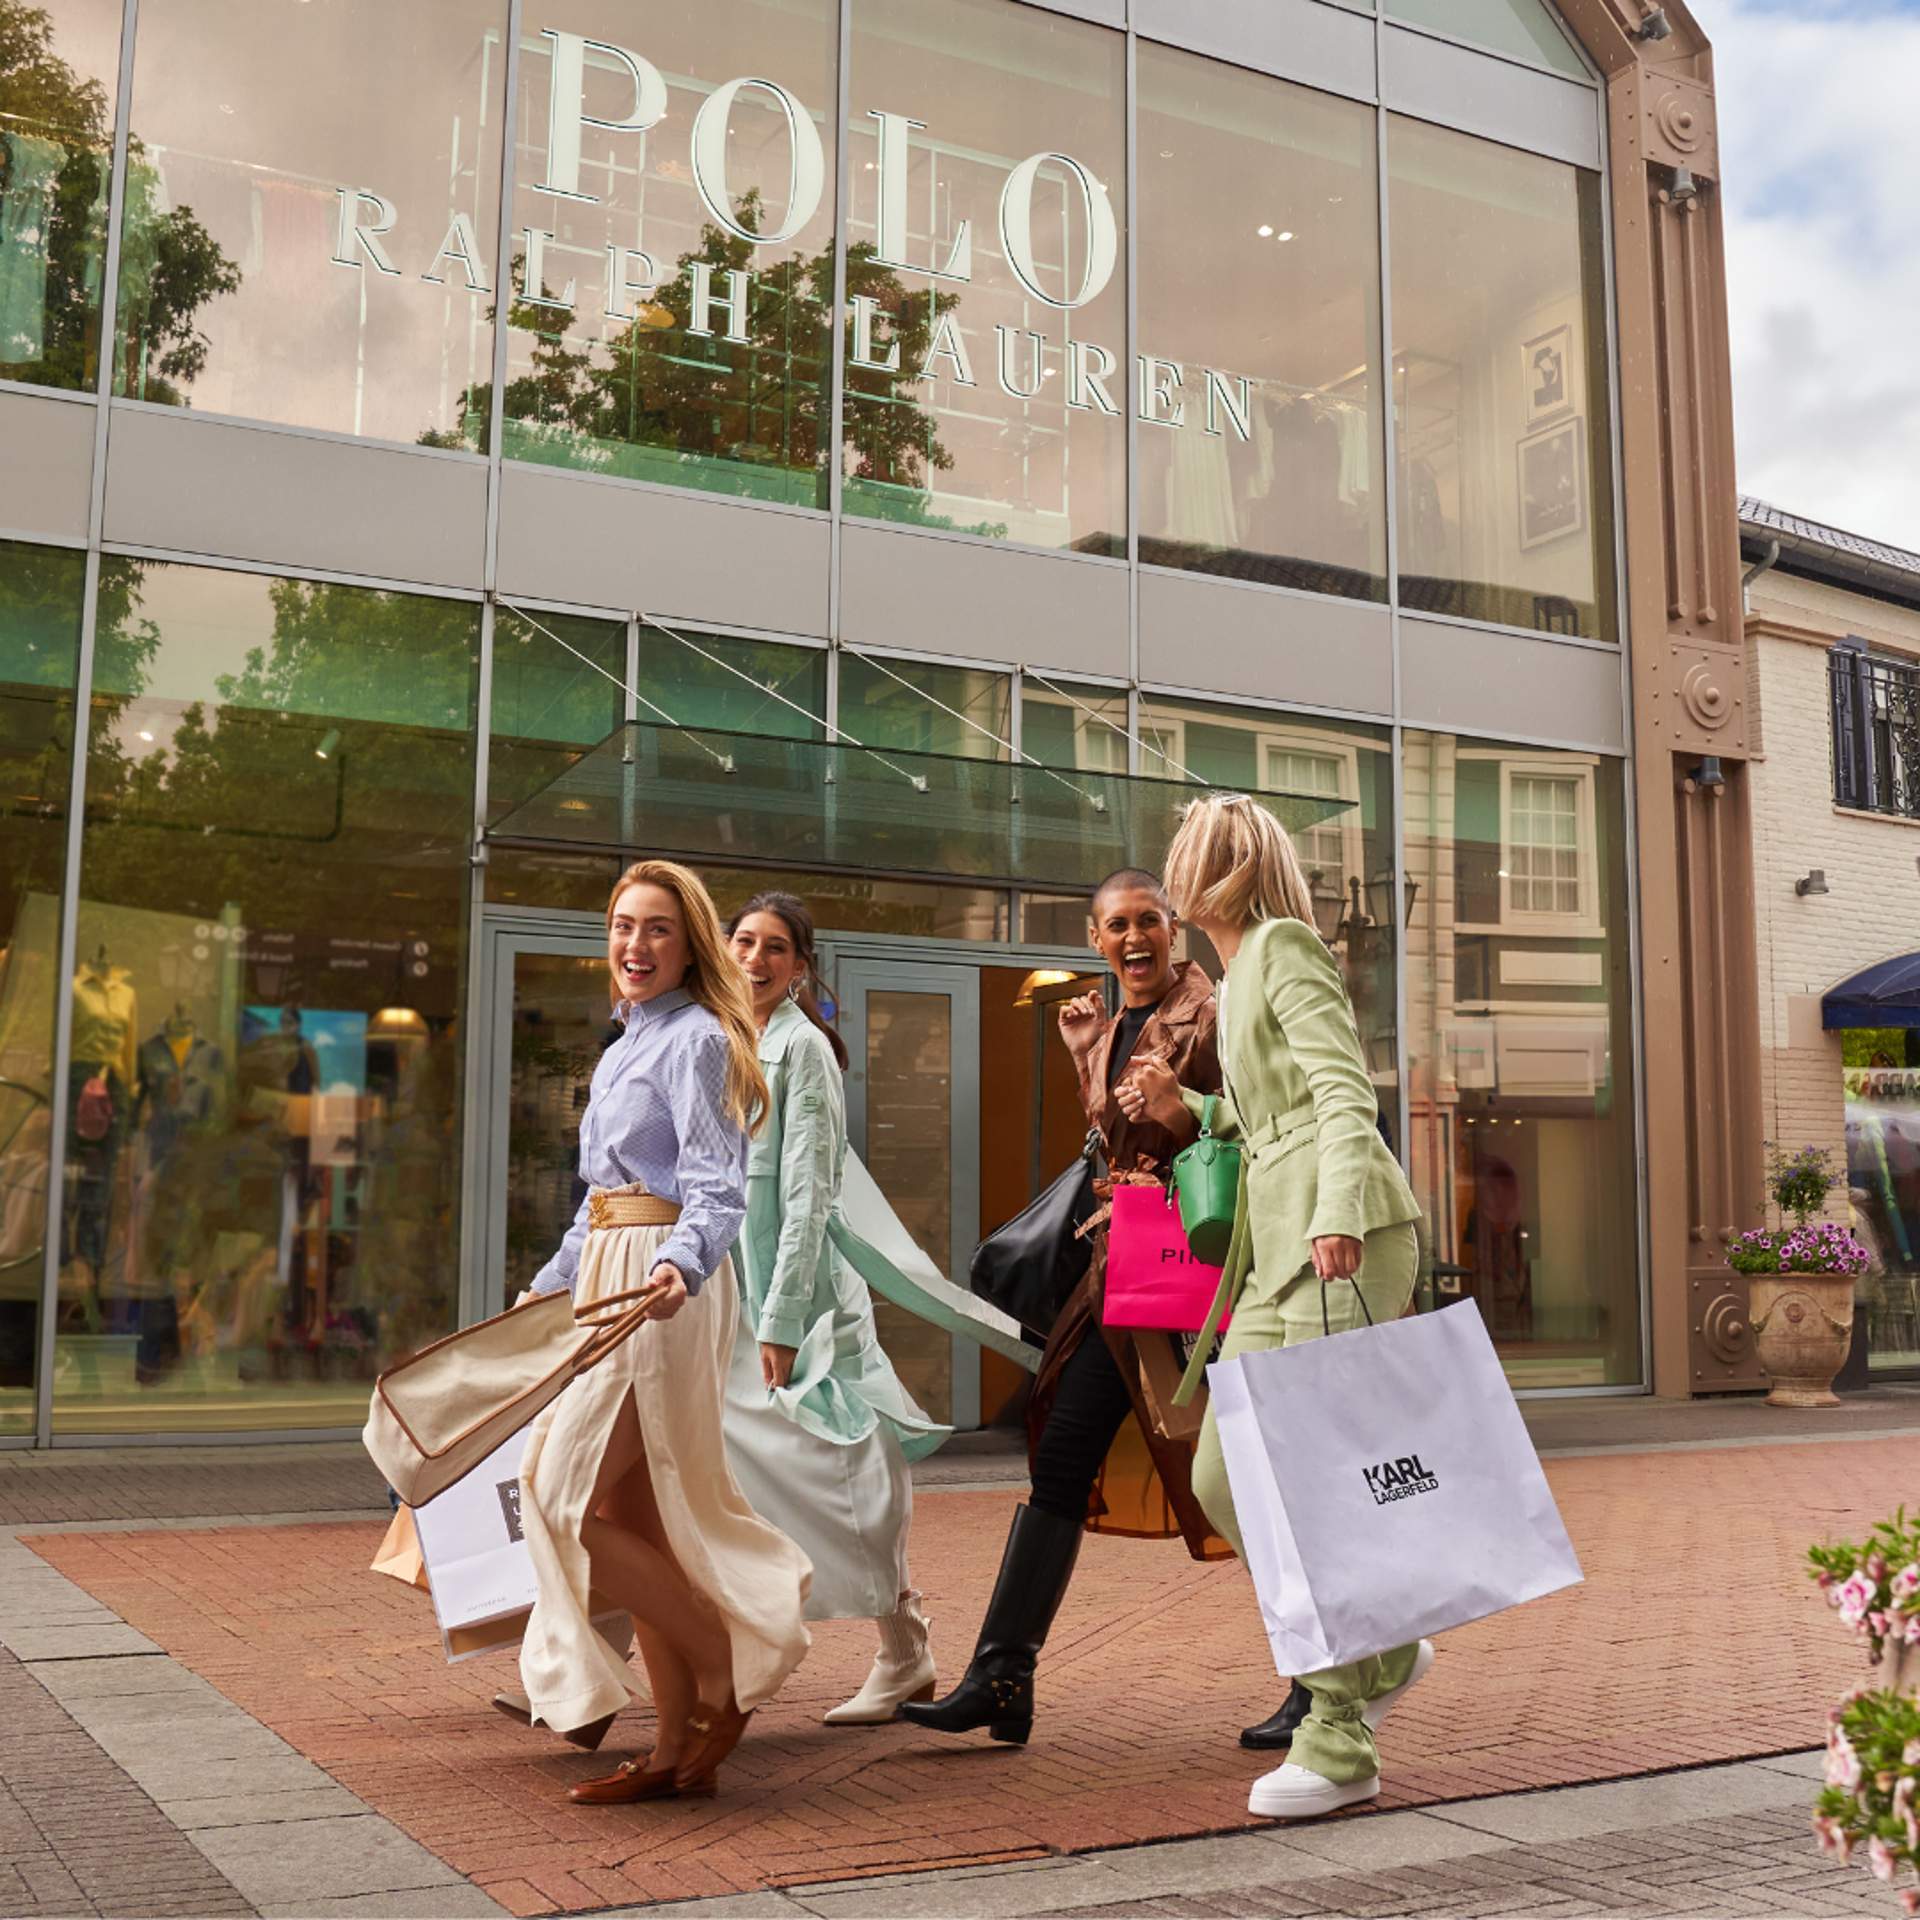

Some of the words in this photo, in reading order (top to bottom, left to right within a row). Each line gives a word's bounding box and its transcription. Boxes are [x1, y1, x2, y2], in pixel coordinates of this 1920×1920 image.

[532, 27, 1117, 308] POLO
[330, 188, 752, 344] RALPH
[849, 294, 1254, 441] LAUREN
[1362, 1454, 1435, 1493] KARL
[1374, 1478, 1439, 1505] LAGERFELD
